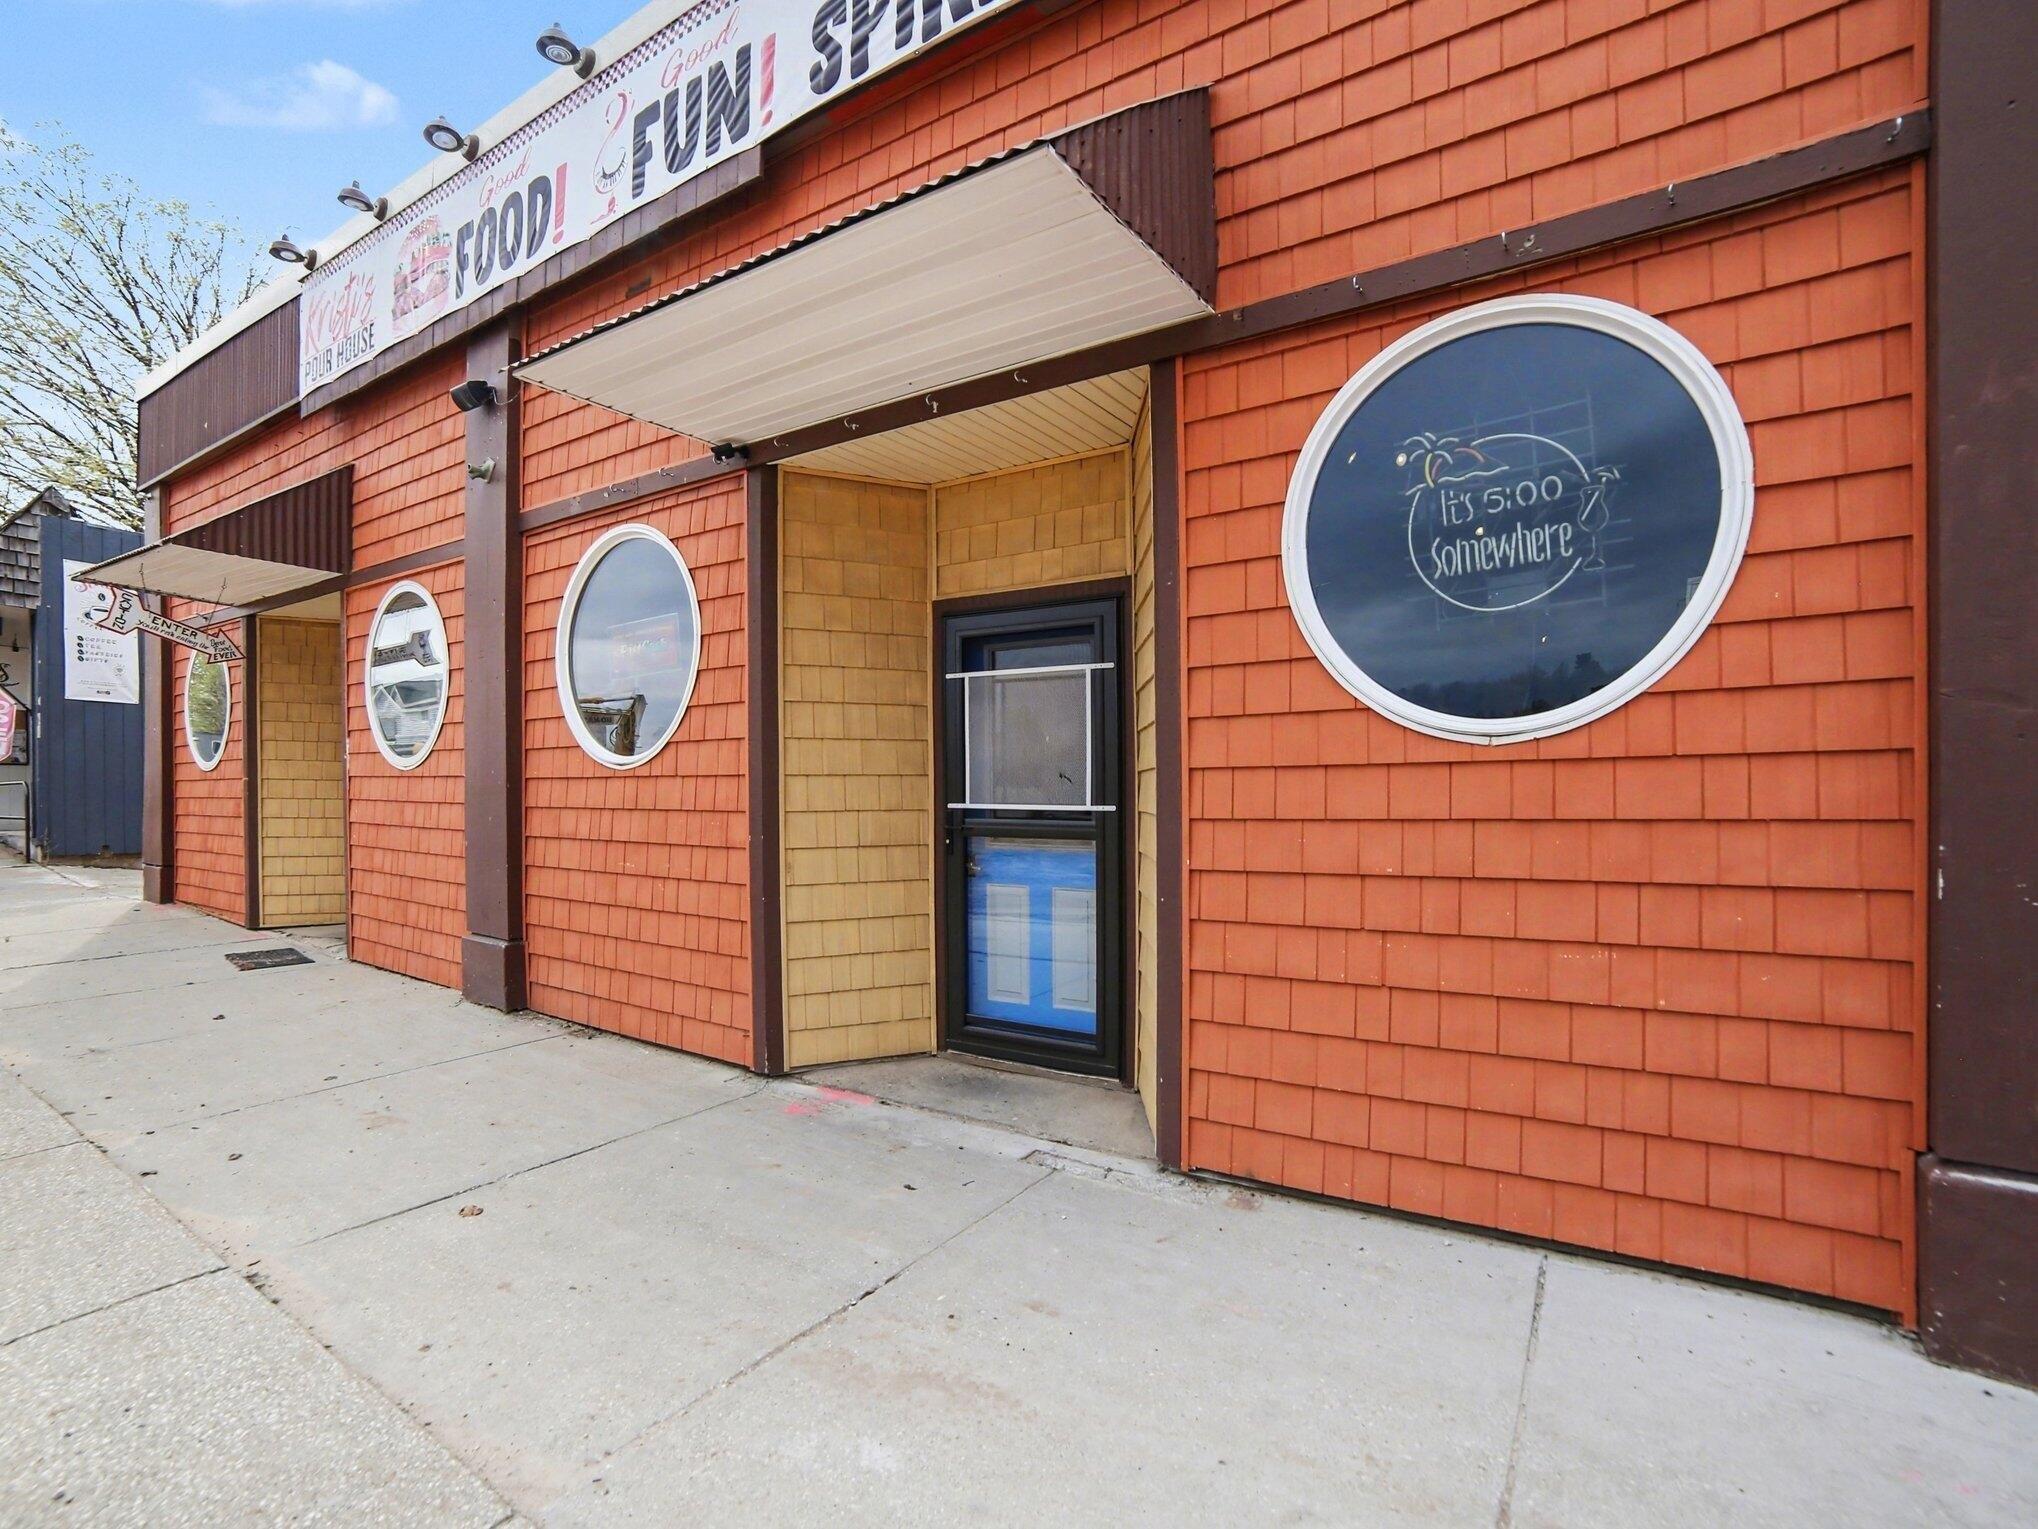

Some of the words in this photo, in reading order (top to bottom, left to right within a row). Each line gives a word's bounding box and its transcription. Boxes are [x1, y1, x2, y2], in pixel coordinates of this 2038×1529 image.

[661, 7, 739, 90] Good
[631, 32, 777, 200] FUN!
[478, 146, 533, 209] Good
[455, 161, 568, 301] FOOD!
[304, 347, 333, 387] POUR
[336, 322, 375, 369] HOUSE
[1440, 489, 1474, 527] It's
[1483, 475, 1563, 514] 5:00
[151, 616, 198, 640] ENTER
[213, 651, 237, 661] EVER
